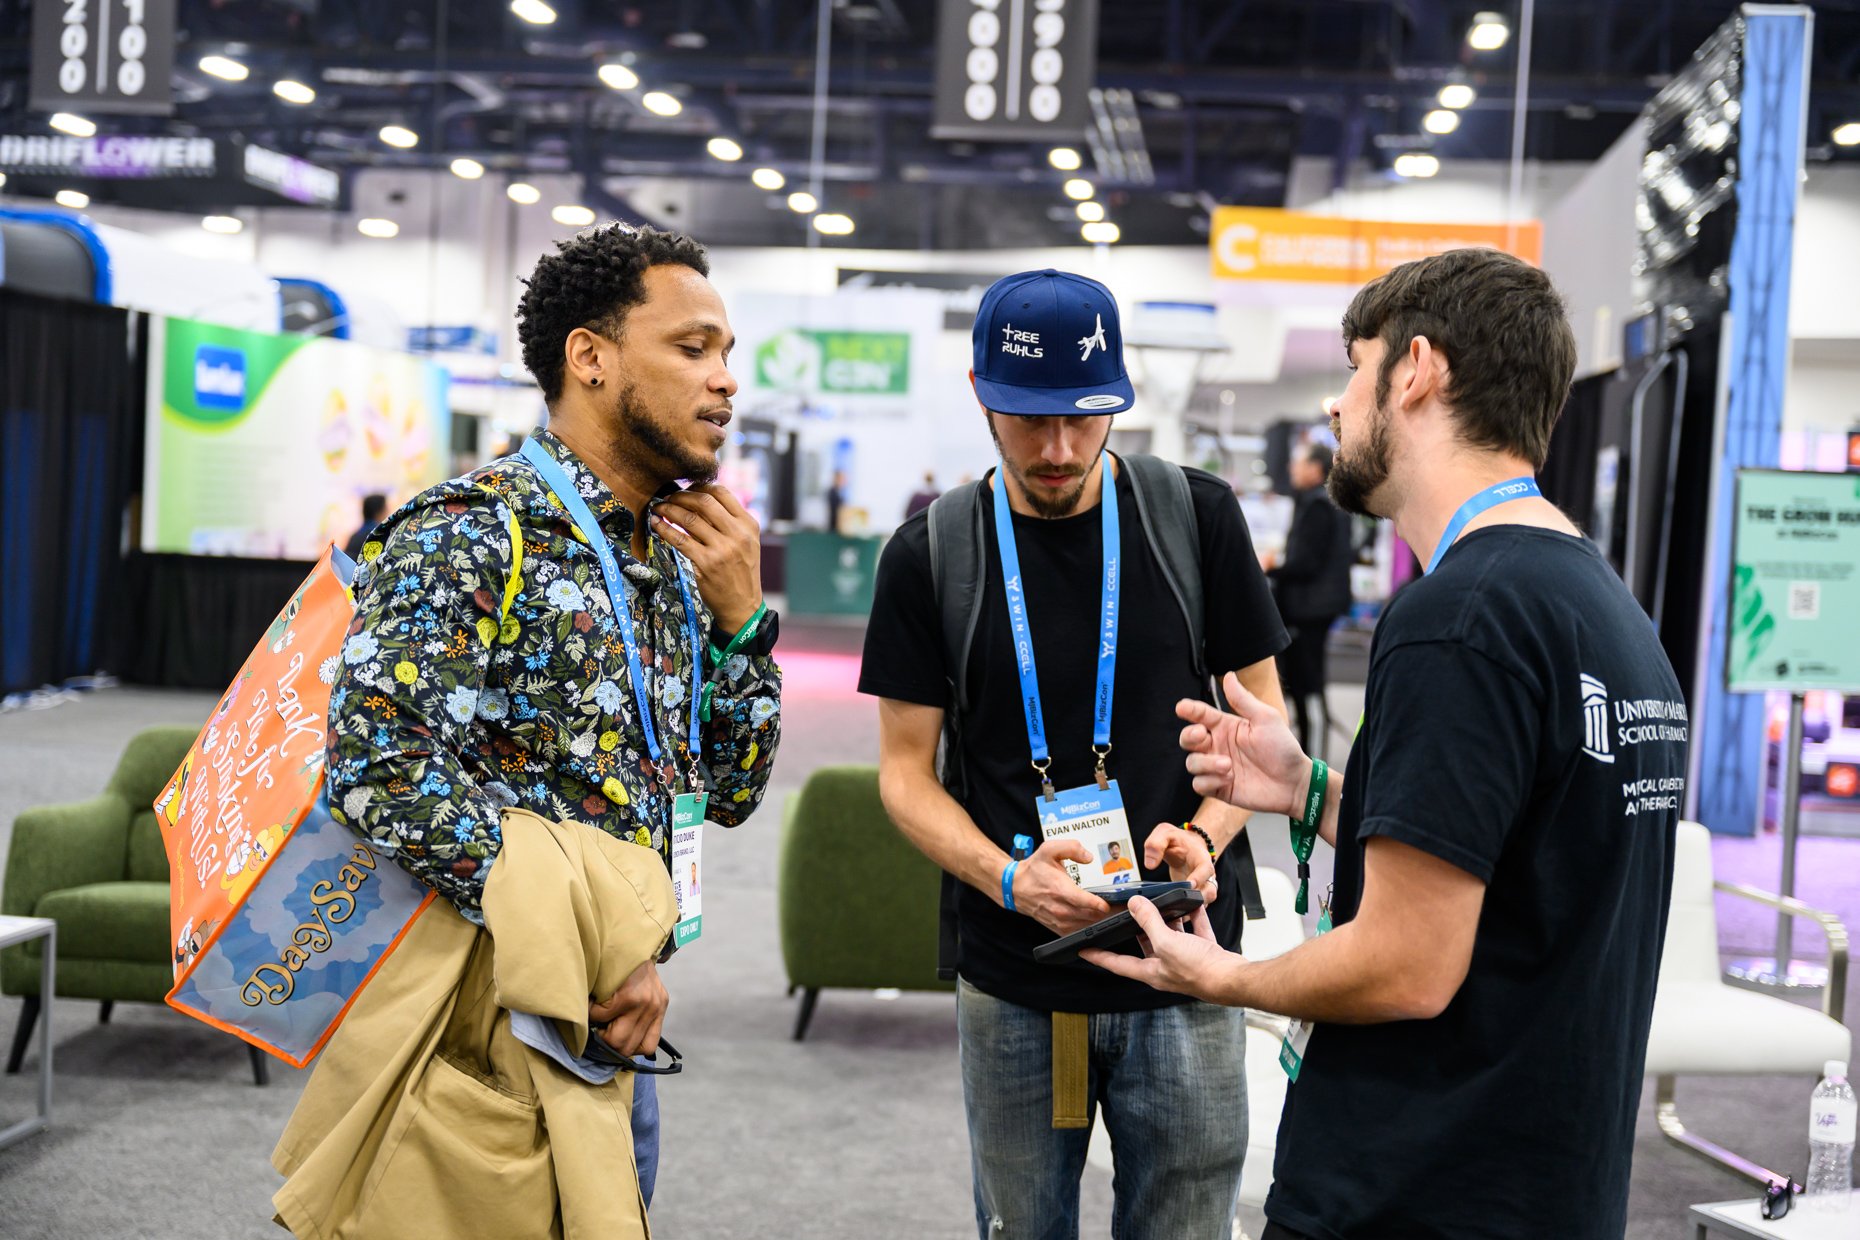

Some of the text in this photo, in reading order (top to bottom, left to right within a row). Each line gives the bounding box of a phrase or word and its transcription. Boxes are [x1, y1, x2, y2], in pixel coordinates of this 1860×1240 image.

[964, 0, 1001, 121] 000
[1029, 0, 1065, 122] 900
[1002, 342, 1043, 358] RUHLS
[601, 543, 617, 582] CCELL
[1107, 557, 1117, 591] CCELL
[1019, 640, 1031, 676] CCELL
[236, 744, 278, 789] for
[213, 721, 250, 857] Smoking
[1046, 816, 1110, 837] EVAN WALTON
[240, 842, 380, 1006] DaySav
